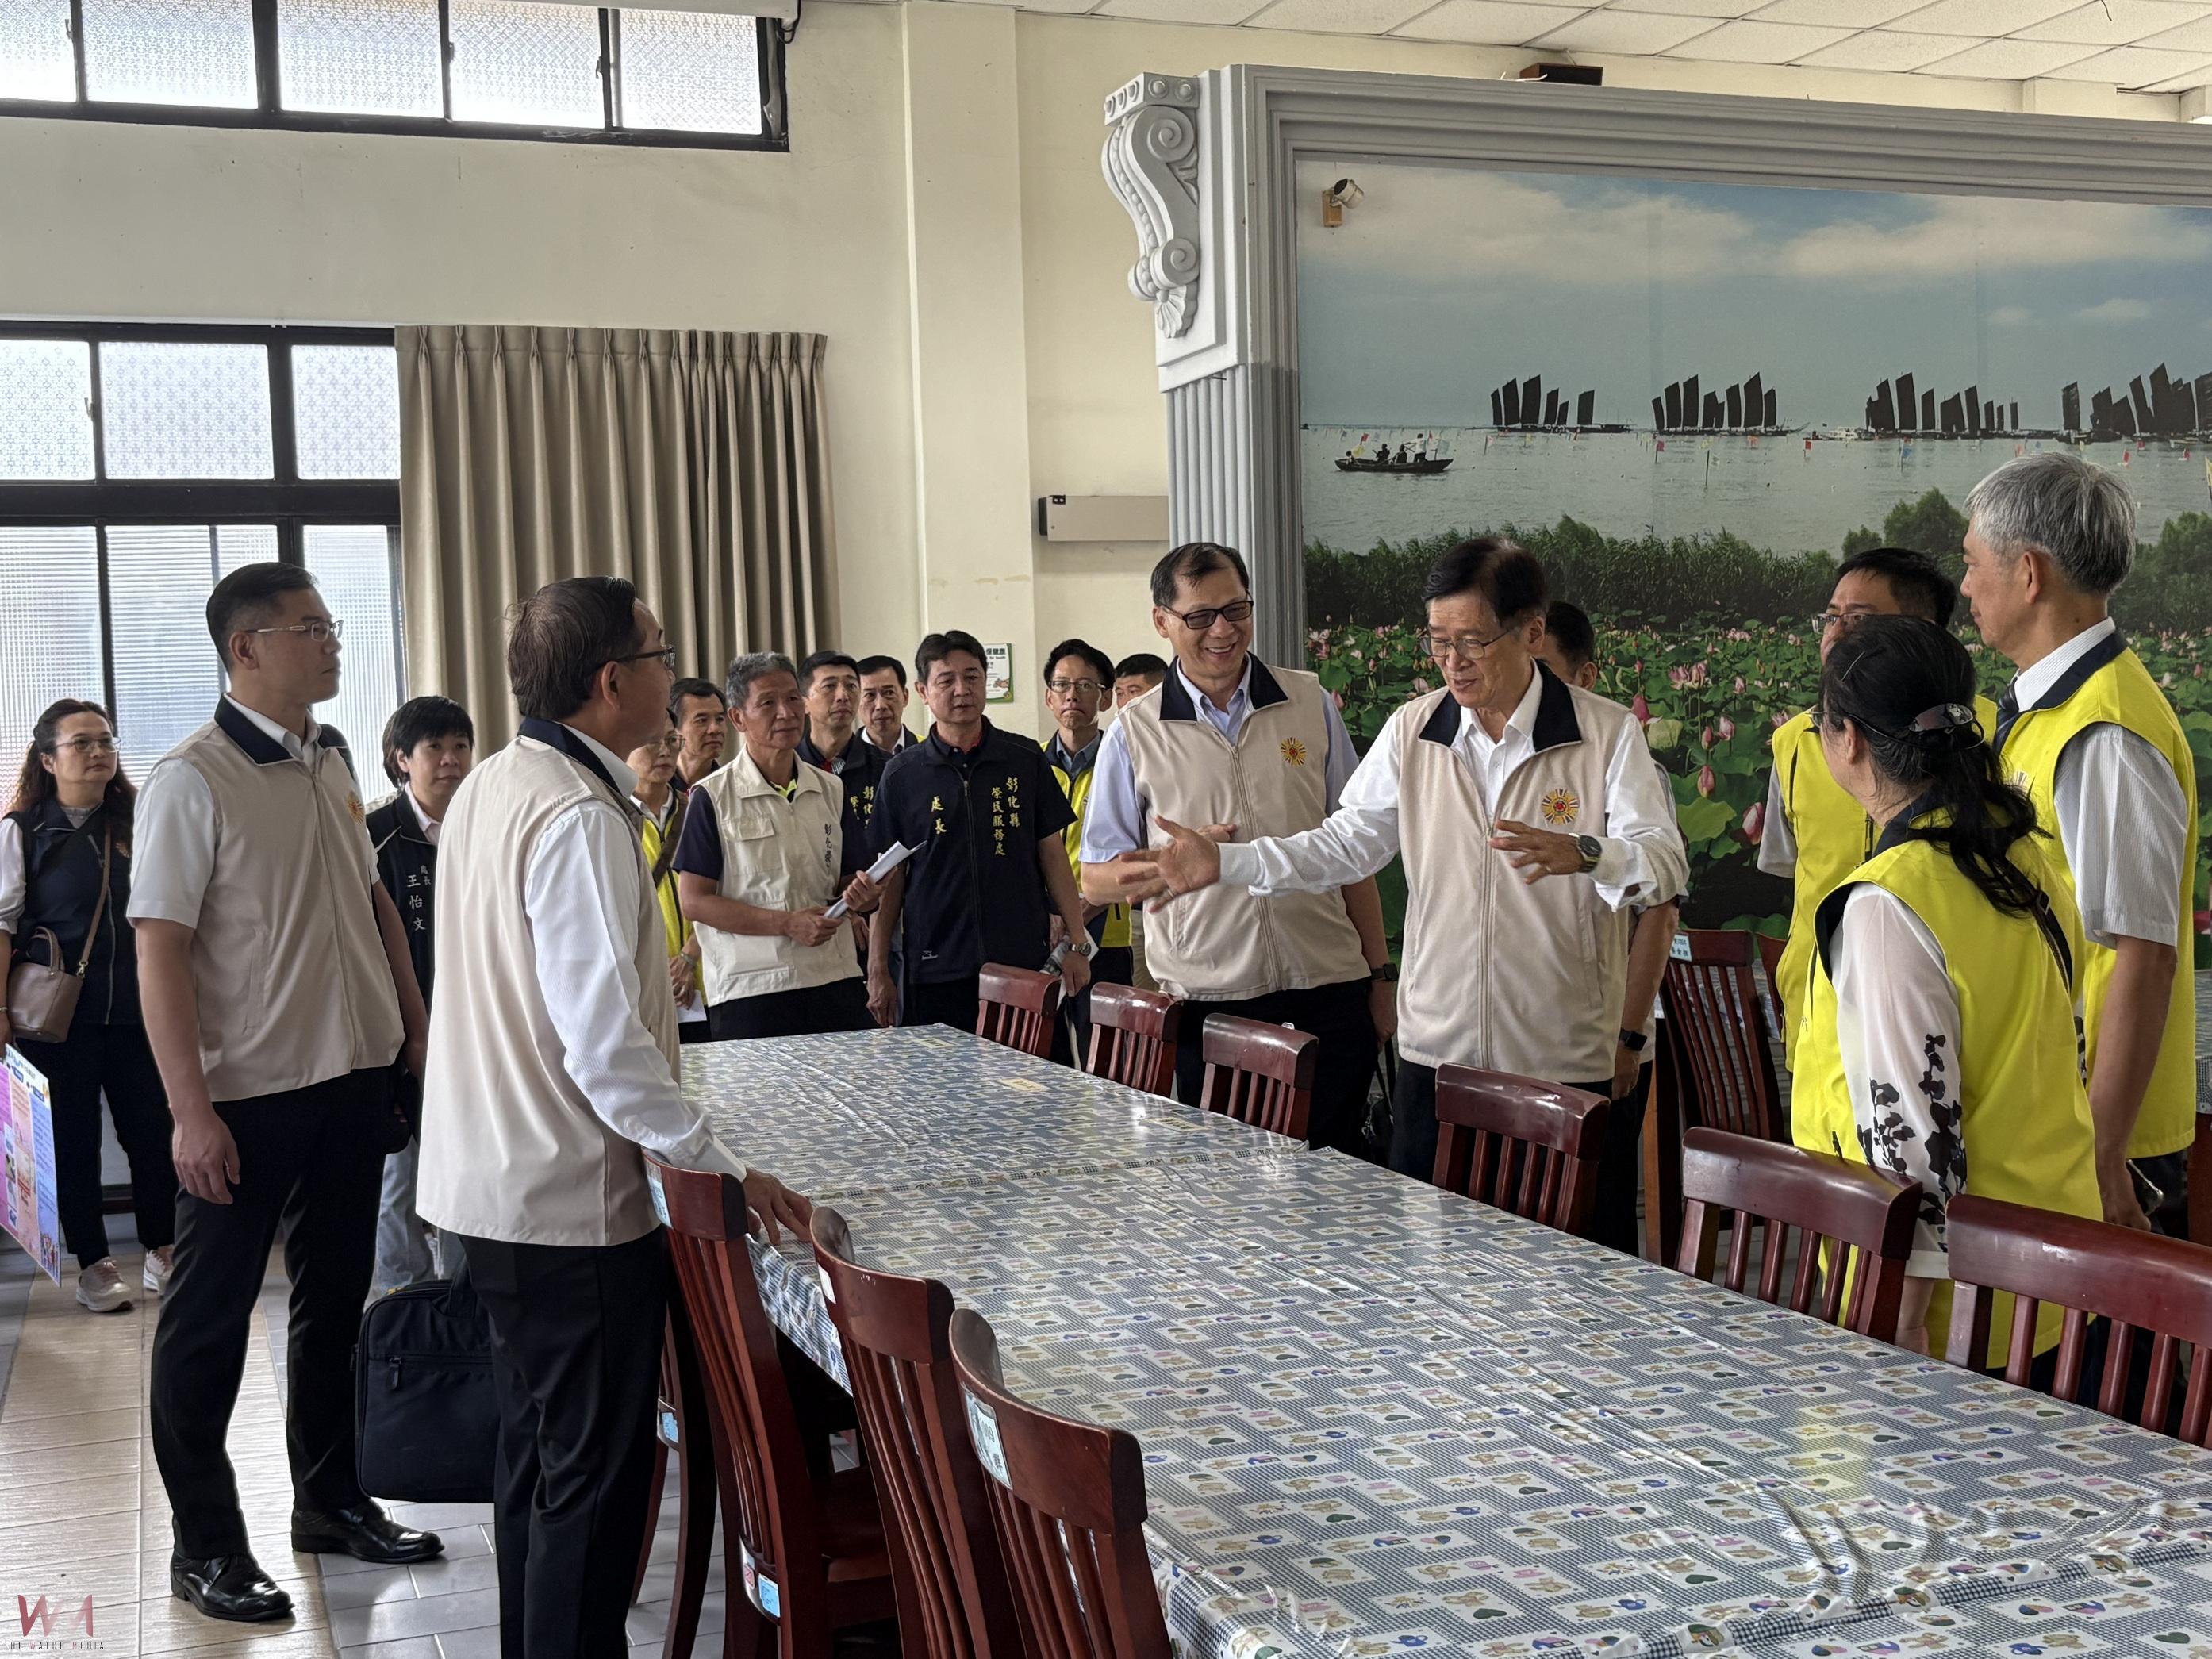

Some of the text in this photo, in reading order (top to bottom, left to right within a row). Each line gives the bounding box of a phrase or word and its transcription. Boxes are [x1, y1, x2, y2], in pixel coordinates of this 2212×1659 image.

[931, 796, 947, 835] 處長
[992, 787, 1006, 855] 榮民服務處
[1006, 777, 1020, 827] 彰化縣
[406, 874, 427, 931] 王怡文
